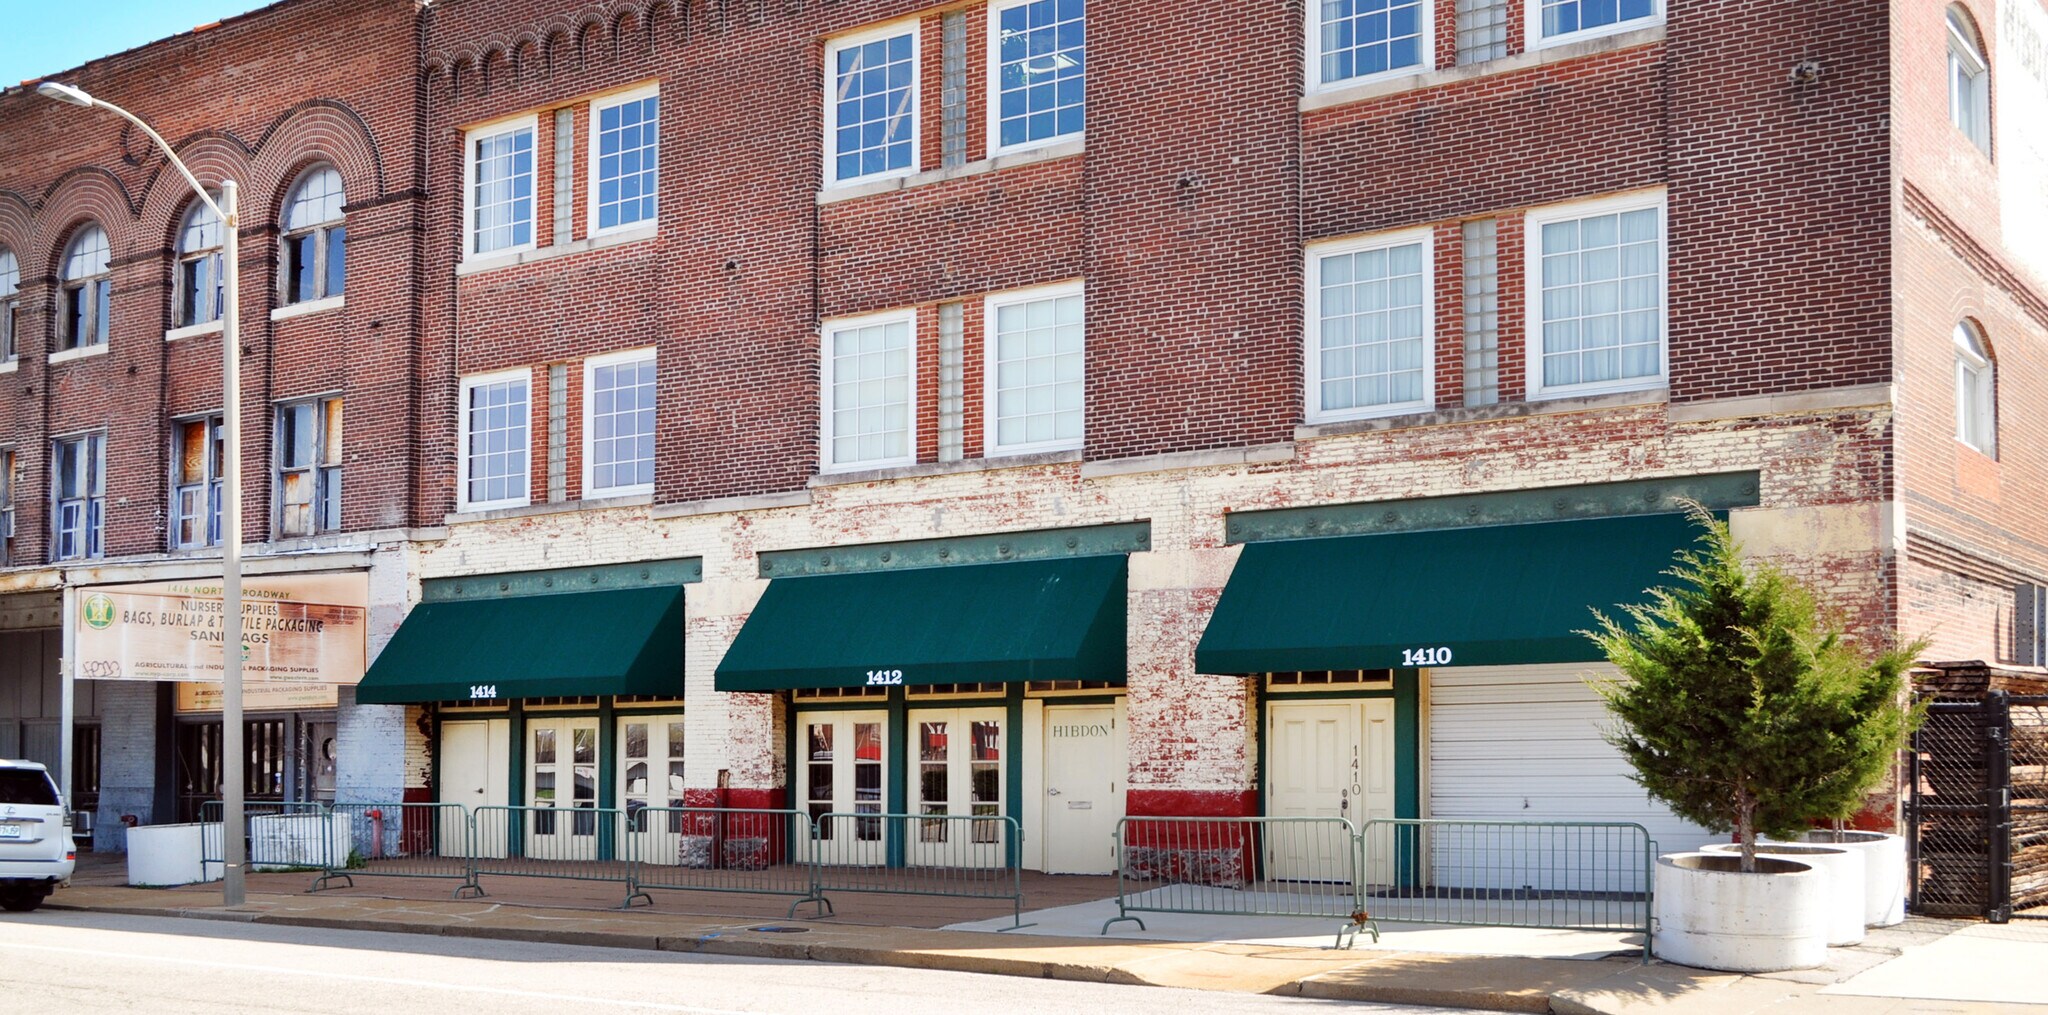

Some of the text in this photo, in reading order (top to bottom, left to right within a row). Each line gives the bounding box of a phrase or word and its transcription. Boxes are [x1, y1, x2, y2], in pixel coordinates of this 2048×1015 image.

[167, 584, 290, 599] 1416 NORT ROADWAY
[180, 600, 278, 616] NURSER UPPLIES
[123, 610, 324, 633] BAGS, BURLAP & TTILE PACKAGING
[190, 630, 269, 644] SANAGS
[1402, 647, 1452, 666] 1410
[134, 661, 188, 670] AGRICULTURAL
[866, 669, 903, 685] 1412
[470, 684, 497, 698] 1414
[1053, 725, 1108, 737] HIBDON
[1351, 744, 1362, 796] 1410
